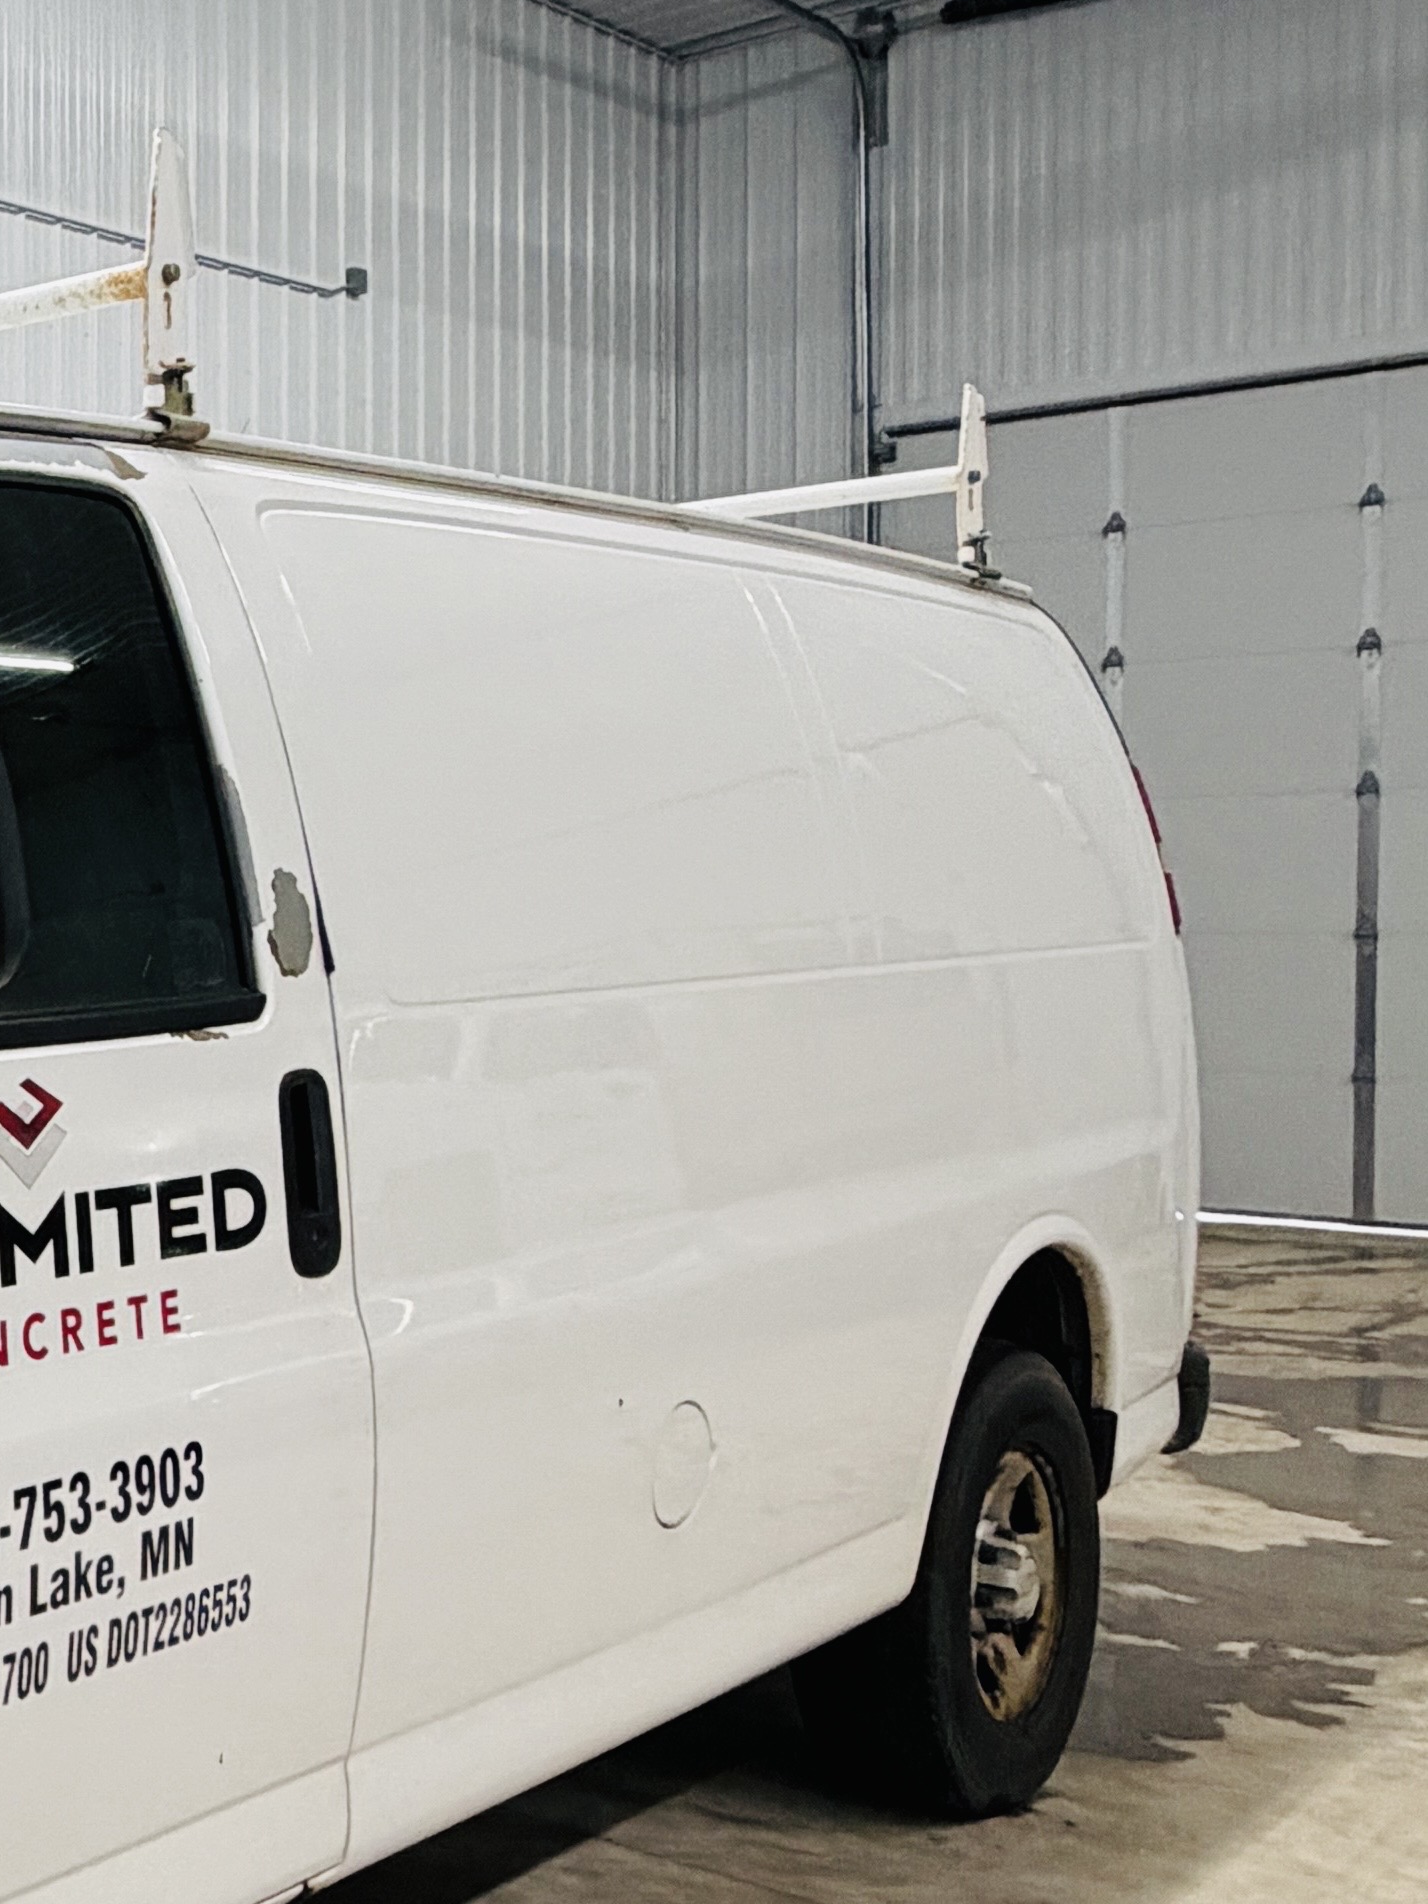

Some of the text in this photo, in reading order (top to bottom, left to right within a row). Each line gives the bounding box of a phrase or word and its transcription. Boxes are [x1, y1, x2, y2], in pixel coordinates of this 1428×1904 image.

[29, 1551, 125, 1617] Lake,
[140, 1516, 194, 1581] MN
[67, 1624, 99, 1683] US
[106, 1574, 252, 1668] DOT2286553
